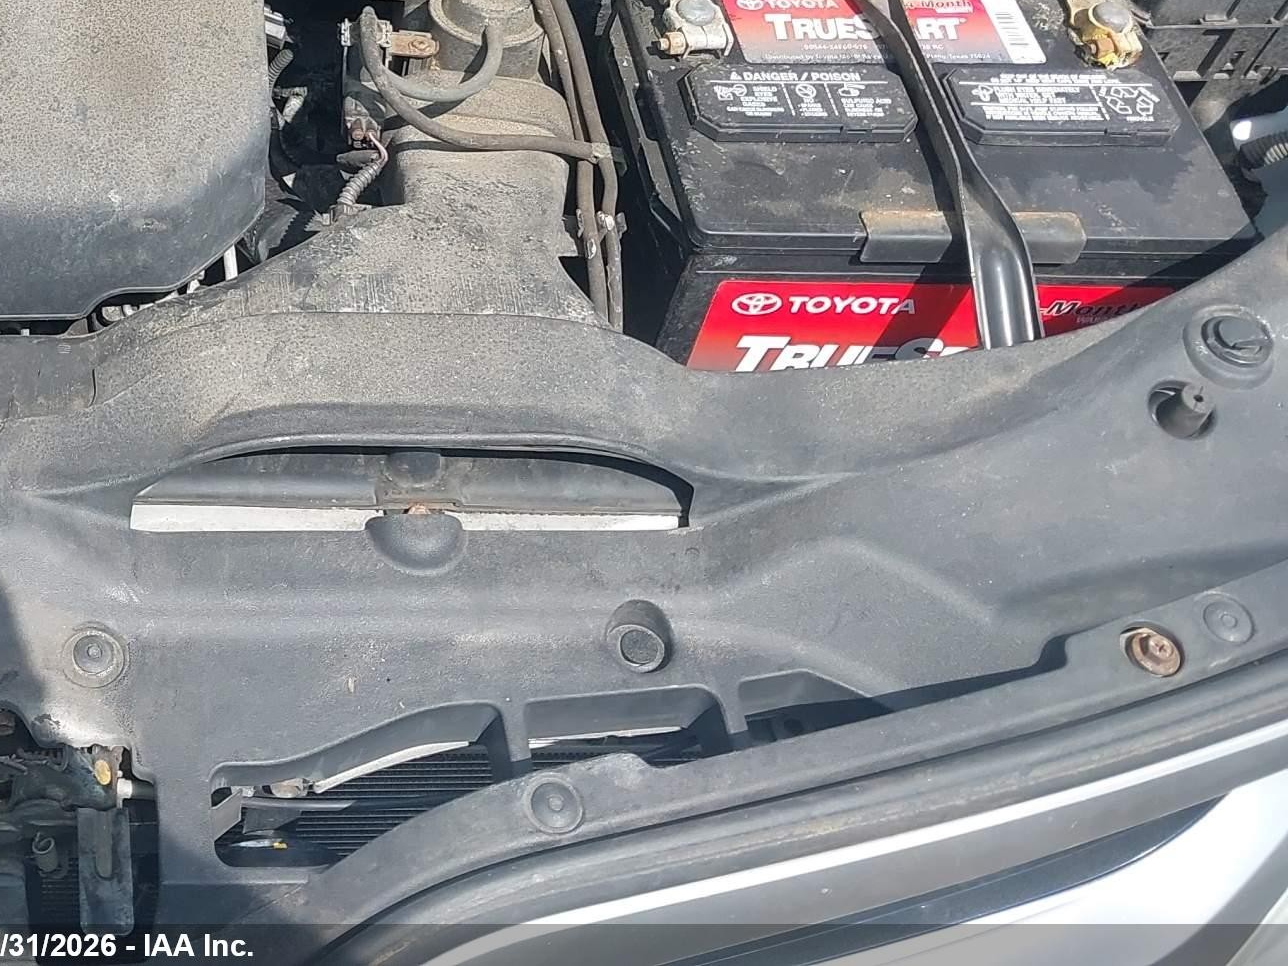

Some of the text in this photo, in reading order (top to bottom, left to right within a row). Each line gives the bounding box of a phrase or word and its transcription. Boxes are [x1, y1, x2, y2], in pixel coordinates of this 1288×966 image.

[742, 71, 799, 81] DANGER
[811, 71, 862, 81] POISON
[789, 295, 916, 315] TOYOTA
